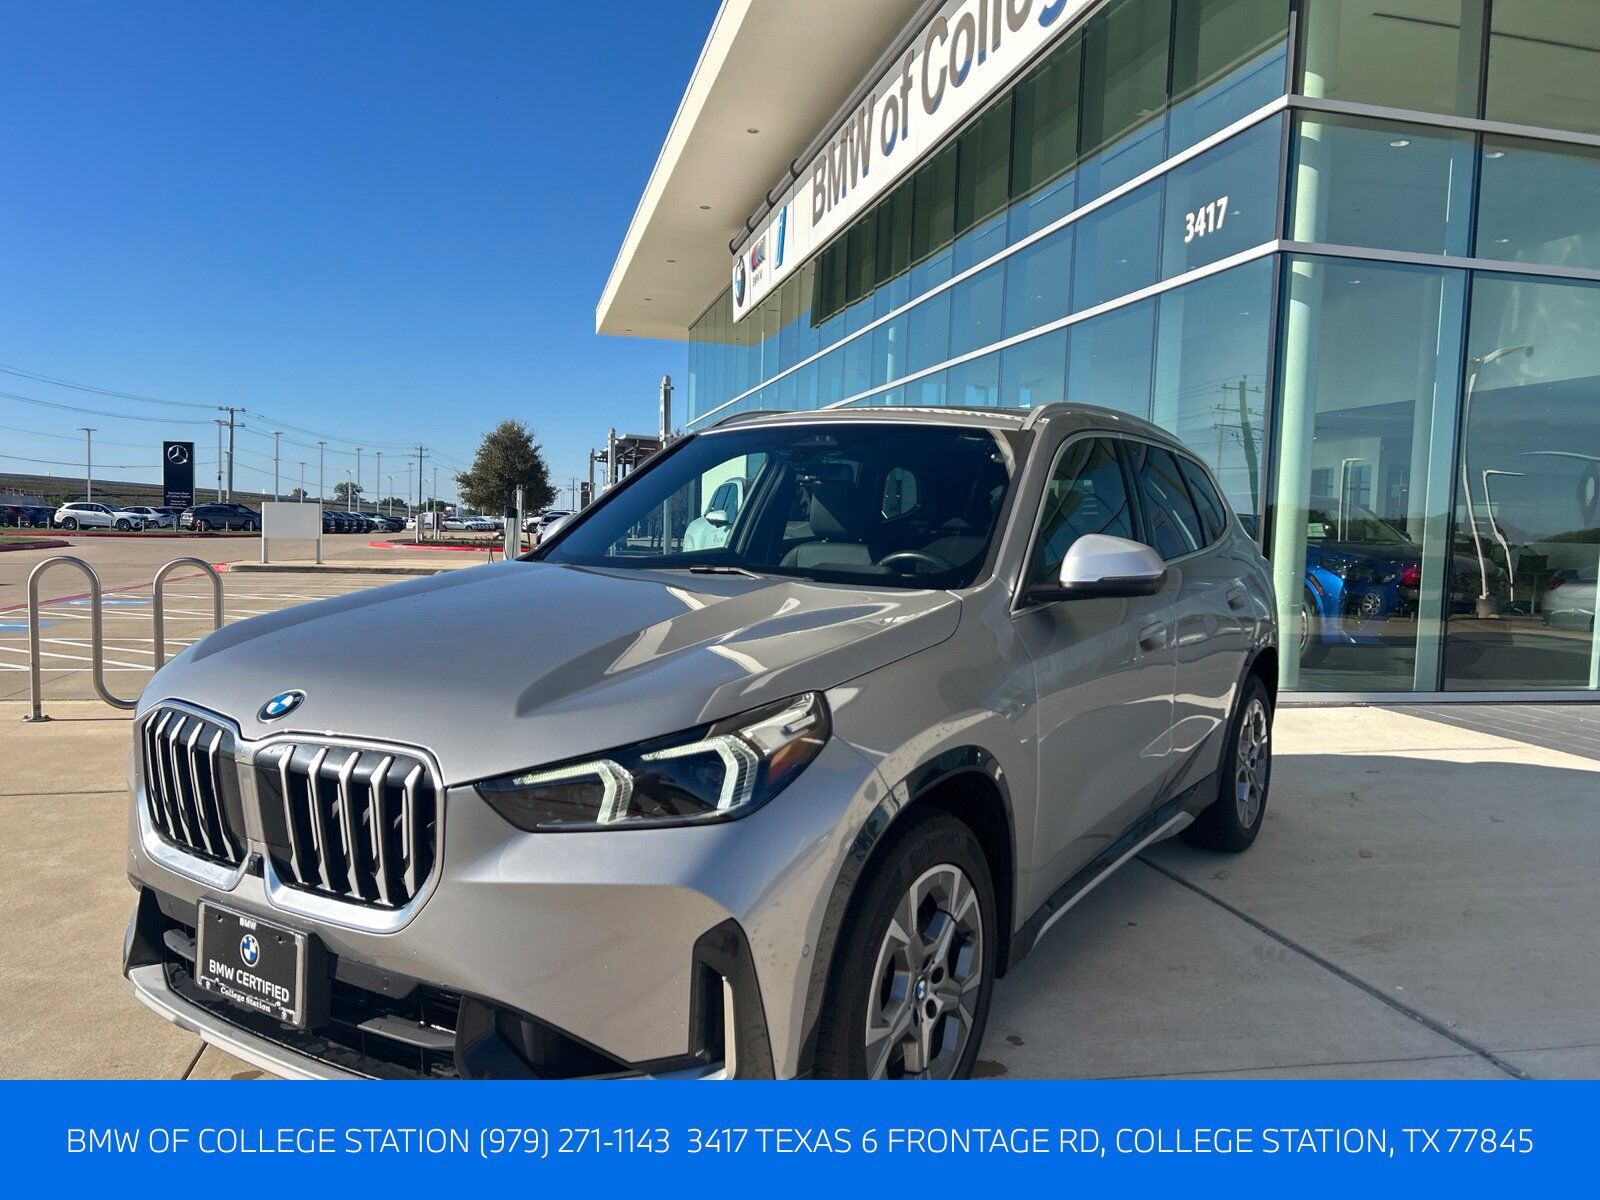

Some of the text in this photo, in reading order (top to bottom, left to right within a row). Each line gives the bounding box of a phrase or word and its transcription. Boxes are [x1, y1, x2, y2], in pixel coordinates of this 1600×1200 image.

[812, 0, 1068, 228] BMW of Coll
[1184, 195, 1228, 243] 3417
[209, 959, 290, 1003] BMW CERTIFIED
[220, 986, 271, 1013] College Station
